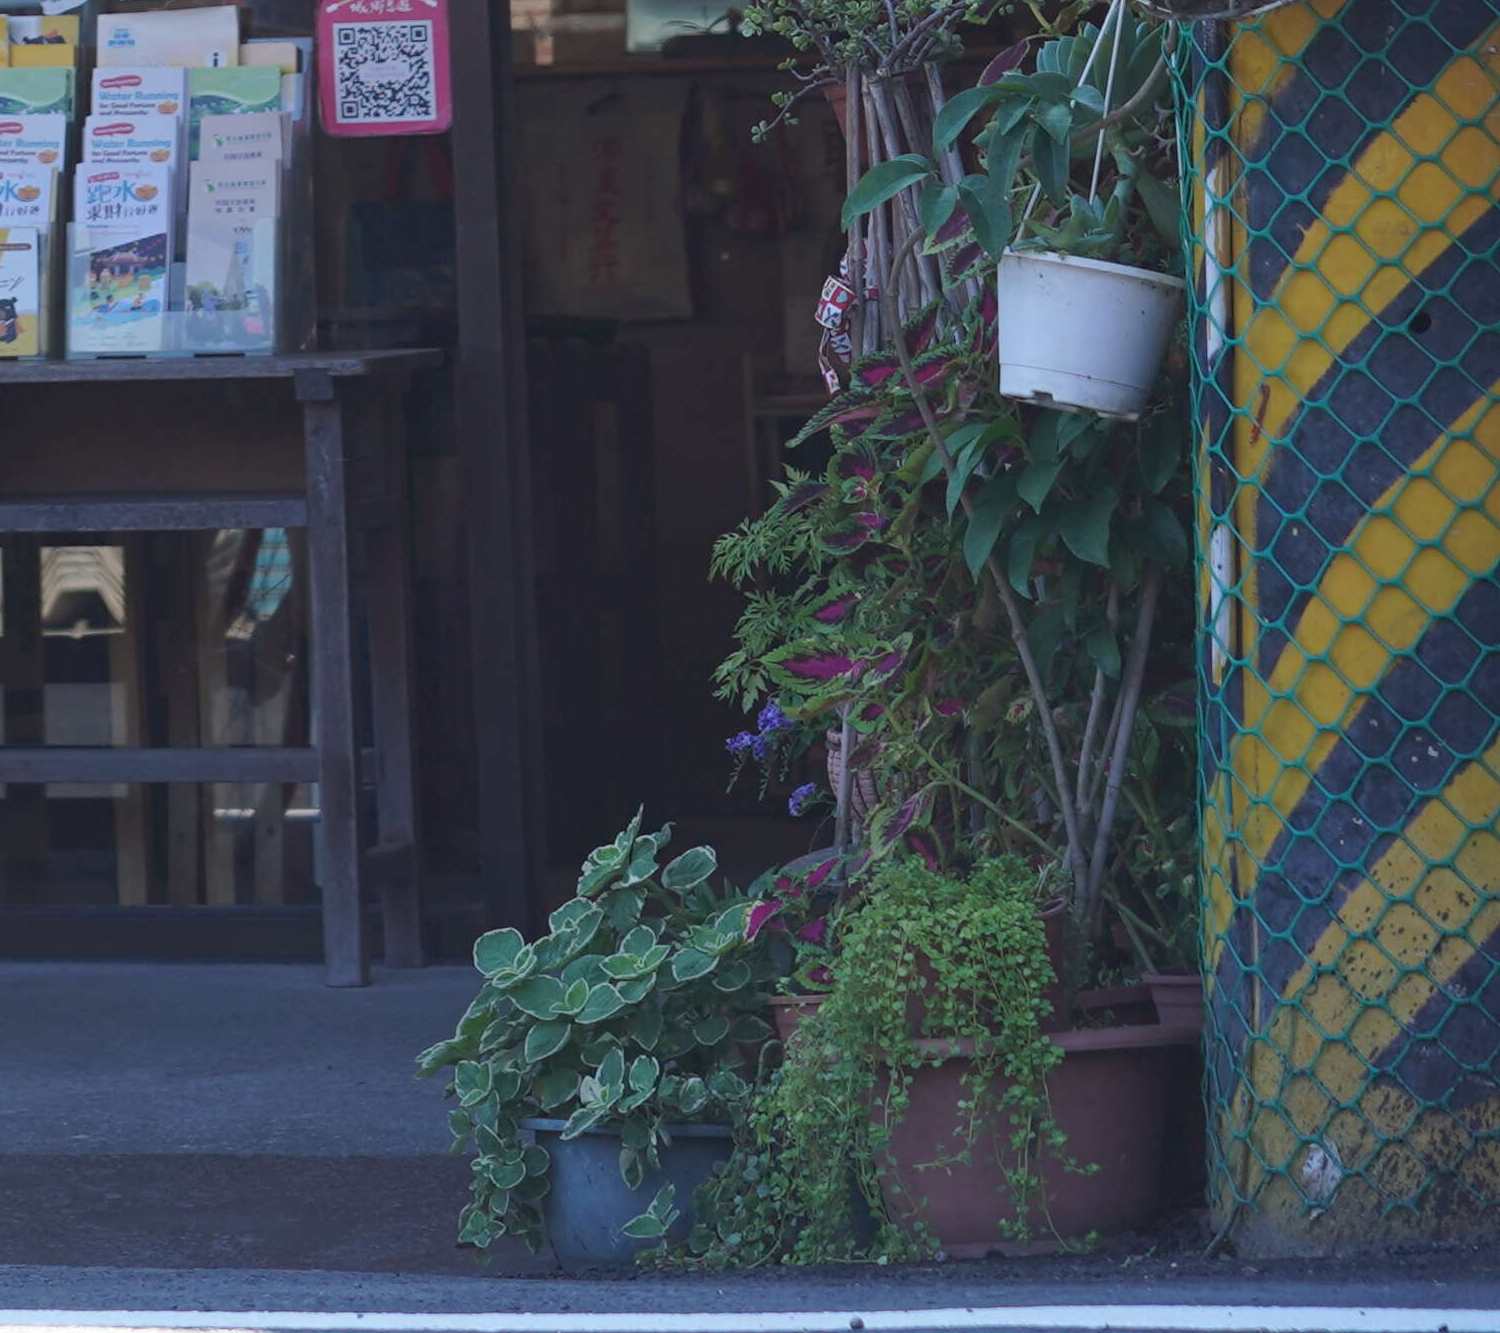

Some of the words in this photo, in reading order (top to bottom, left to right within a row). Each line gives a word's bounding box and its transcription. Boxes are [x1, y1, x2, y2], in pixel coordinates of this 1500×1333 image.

[99, 91, 132, 101] Water
[135, 91, 179, 101] Running
[16, 139, 60, 149] Running
[91, 139, 125, 148] Water
[127, 139, 171, 148] Running
